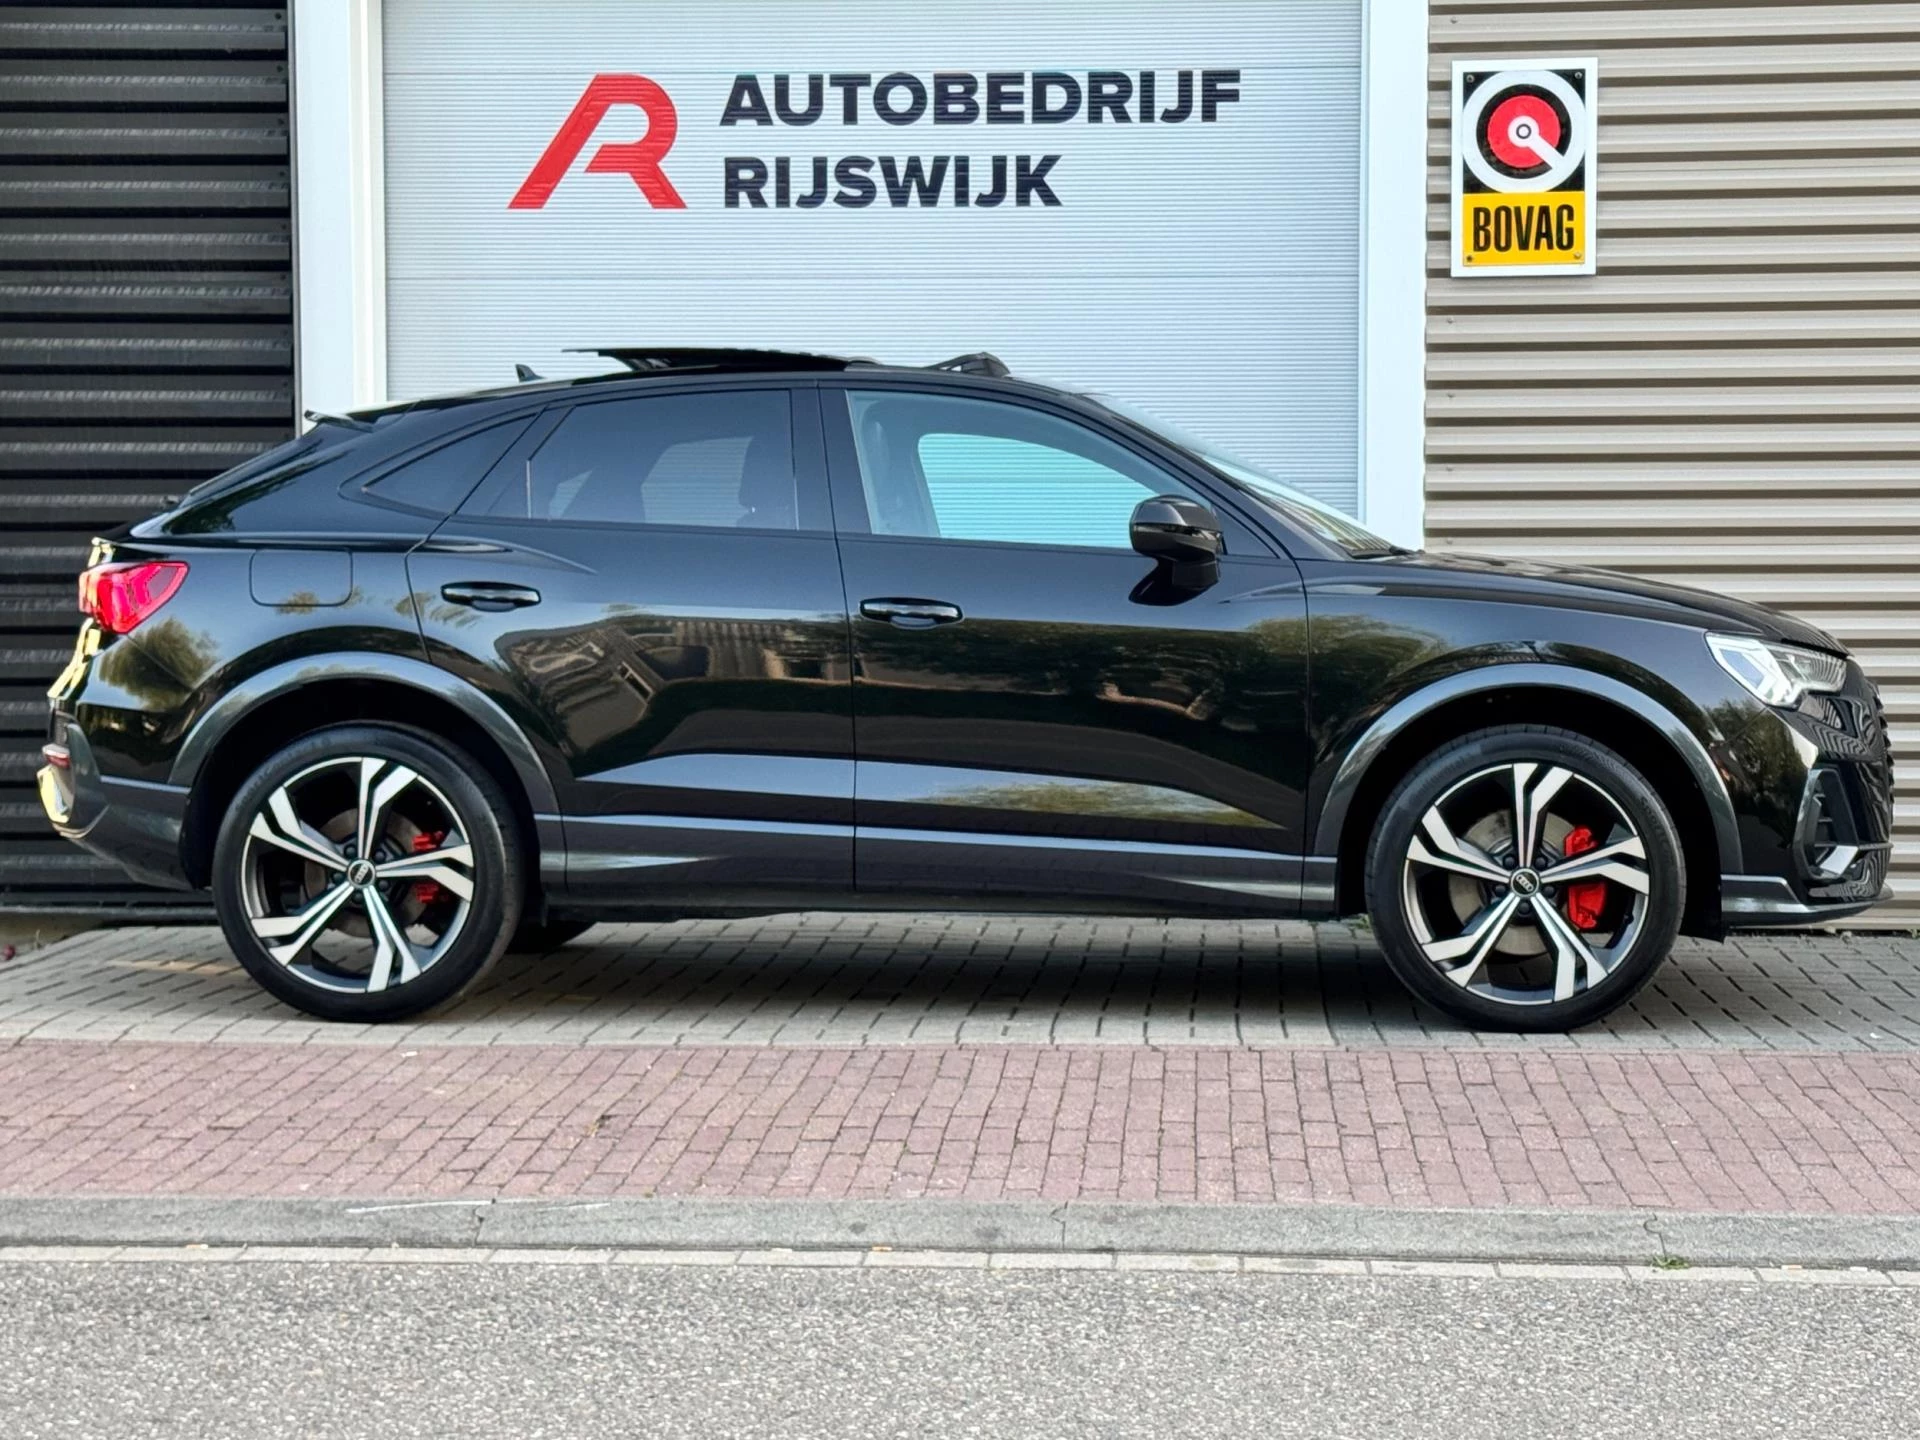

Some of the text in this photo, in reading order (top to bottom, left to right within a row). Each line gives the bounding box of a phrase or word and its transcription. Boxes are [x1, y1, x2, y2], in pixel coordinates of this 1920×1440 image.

[719, 69, 1242, 127] AUTOBEDRIJF
[724, 154, 1064, 209] RIJSWIJK
[1473, 204, 1575, 252] BOVAG
